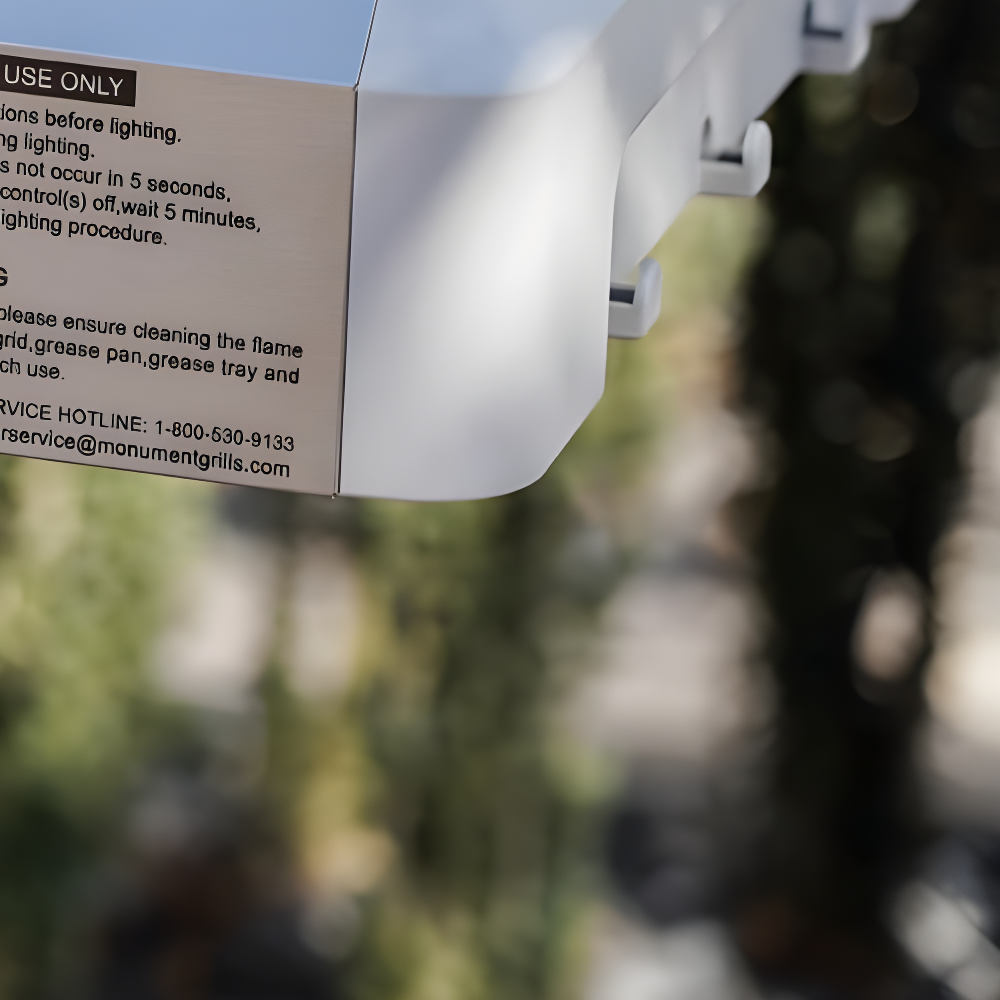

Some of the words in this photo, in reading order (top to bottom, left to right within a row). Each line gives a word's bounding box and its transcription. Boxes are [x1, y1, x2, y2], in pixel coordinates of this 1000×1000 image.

[3, 63, 53, 90] USE
[59, 70, 125, 98] ONLY
[45, 108, 105, 133] before
[109, 116, 182, 146] lighting.
[24, 132, 95, 162] lighting.
[16, 161, 46, 179] not
[50, 166, 103, 185] occur
[107, 169, 124, 188] in
[129, 171, 142, 190] 5
[0, 186, 87, 213] control(s)
[92, 194, 160, 219] off,wait
[163, 202, 177, 221] 5
[181, 206, 261, 234] minutes,
[68, 220, 168, 246] procedure.
[62, 316, 127, 336] ensure
[133, 321, 211, 351] cleaning
[217, 331, 246, 351] the
[251, 335, 304, 359] flame
[26, 363, 66, 381] use.
[221, 358, 259, 383] tray
[263, 367, 300, 385] and
[58, 405, 148, 434] HOTLINE:
